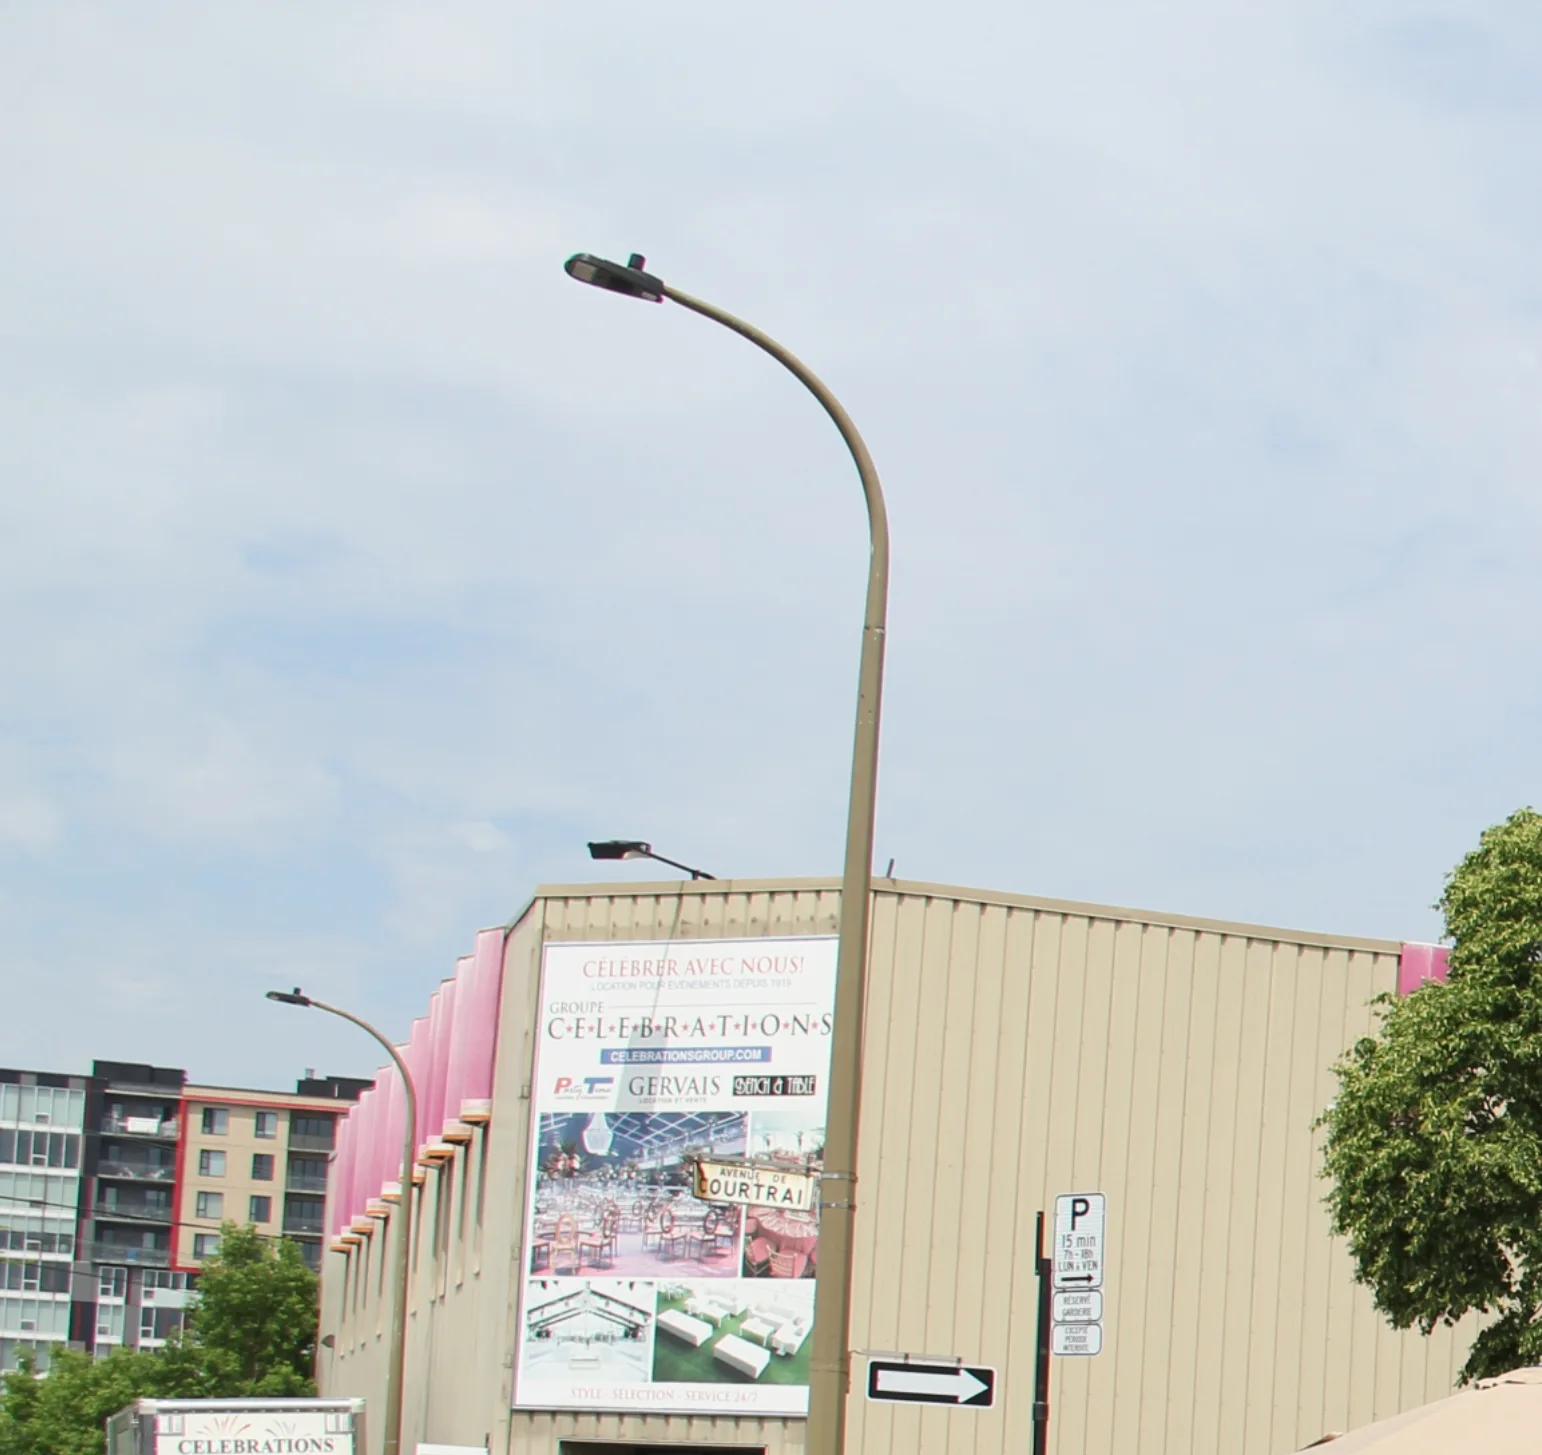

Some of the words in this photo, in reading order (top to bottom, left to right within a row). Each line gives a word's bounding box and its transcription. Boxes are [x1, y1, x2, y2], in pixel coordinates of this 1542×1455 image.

[583, 956, 680, 978] CÉLÉBRER
[684, 957, 735, 977] AVEC
[741, 956, 805, 975] NOUS!
[591, 981, 637, 992] LOCATION
[639, 980, 666, 991] POUR
[732, 978, 768, 989] DEPUIS
[771, 977, 792, 988] 1919
[549, 1001, 605, 1014] GROUPE
[610, 1048, 762, 1063] CELEBRATIONSGROUP.COM
[629, 1074, 721, 1097] GERVAIS
[734, 1077, 771, 1095] BENCH
[786, 1076, 815, 1095] TABLE
[720, 1167, 761, 1180] AVENUE
[772, 1174, 787, 1184] DE
[1071, 1198, 1090, 1231] P
[1061, 1234, 1073, 1249] 15
[1076, 1233, 1096, 1248] min
[1058, 1261, 1075, 1272] LUN
[1081, 1260, 1098, 1271] VEN
[570, 1388, 601, 1399] STYLE
[685, 1389, 730, 1402] SERVICE
[734, 1391, 758, 1402] 24/7
[178, 1438, 335, 1455] CELEBRATIONS
